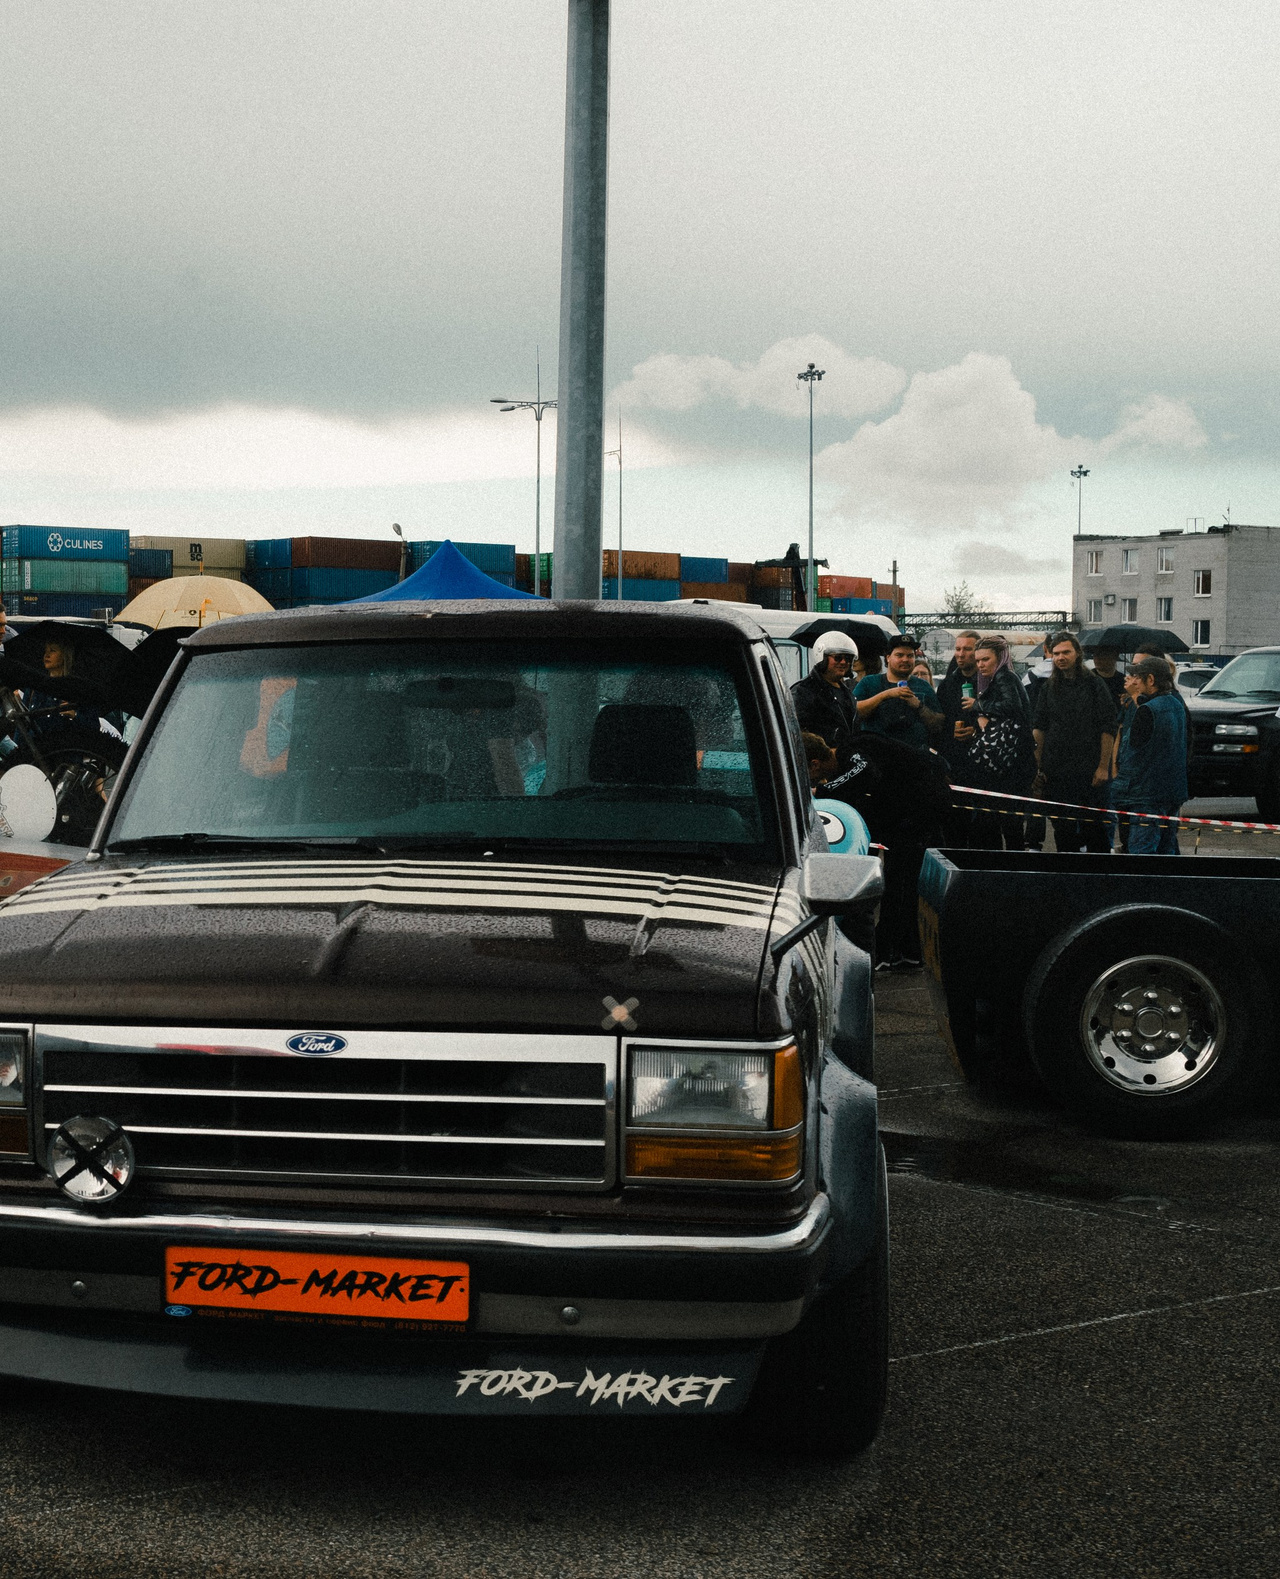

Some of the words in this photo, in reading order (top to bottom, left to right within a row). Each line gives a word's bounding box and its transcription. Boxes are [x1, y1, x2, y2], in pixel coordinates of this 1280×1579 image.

[64, 538, 104, 550] CULINES
[297, 1034, 337, 1052] Ford
[453, 1366, 736, 1409] FORD-MARKET
